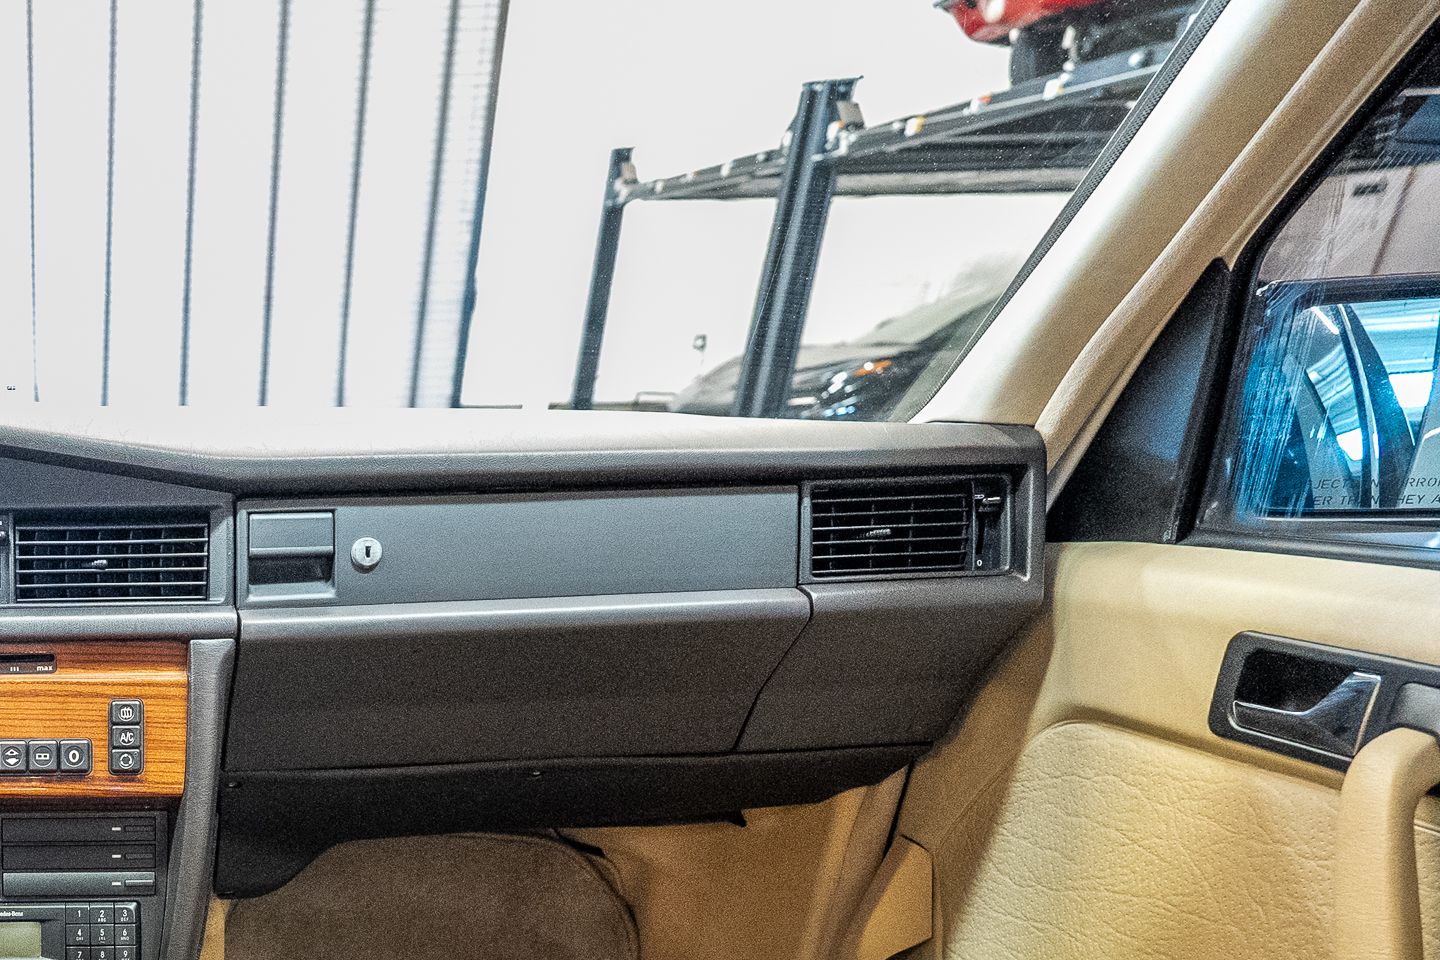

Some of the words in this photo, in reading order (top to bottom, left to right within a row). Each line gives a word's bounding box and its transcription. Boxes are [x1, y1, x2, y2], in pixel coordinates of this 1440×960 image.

[36, 663, 54, 671] max
[119, 732, 135, 744] A/C
[77, 909, 81, 918] 1
[99, 909, 105, 918] 2
[122, 909, 128, 917] 3
[77, 928, 82, 937] 4
[100, 928, 105, 937] 5
[122, 928, 128, 937] 6
[77, 951, 83, 959] 7
[100, 950, 105, 959] 8
[123, 950, 128, 958] 9
